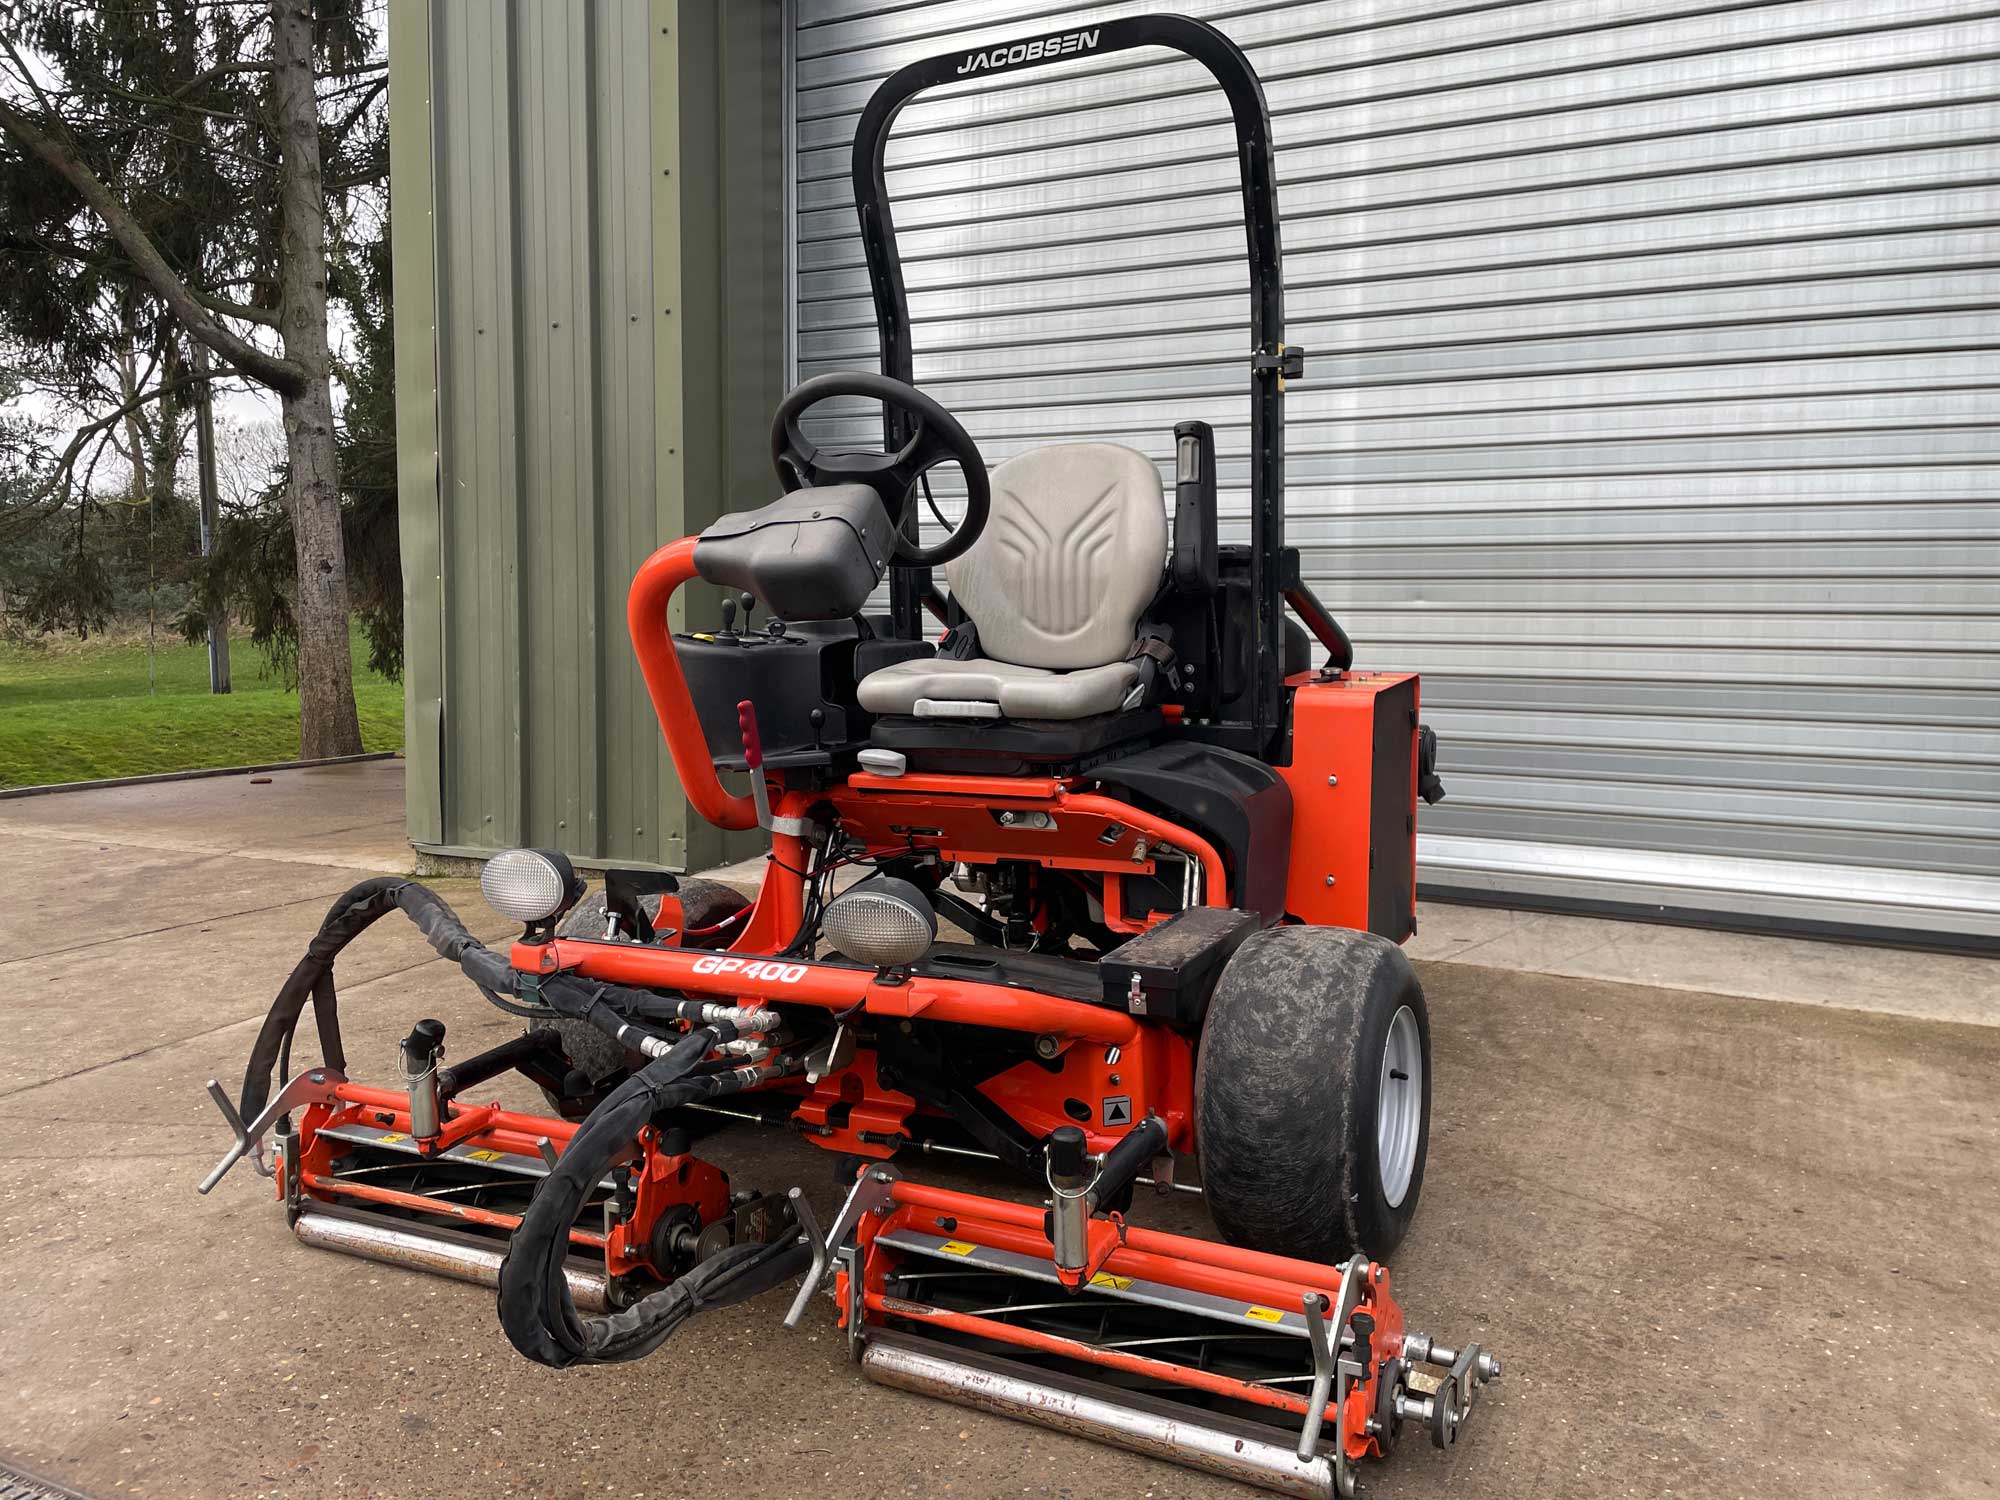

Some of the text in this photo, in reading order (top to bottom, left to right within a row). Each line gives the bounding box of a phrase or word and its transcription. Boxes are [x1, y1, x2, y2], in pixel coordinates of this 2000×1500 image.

[957, 29, 1100, 74] JACOBSEN
[692, 956, 808, 983] GP 400
